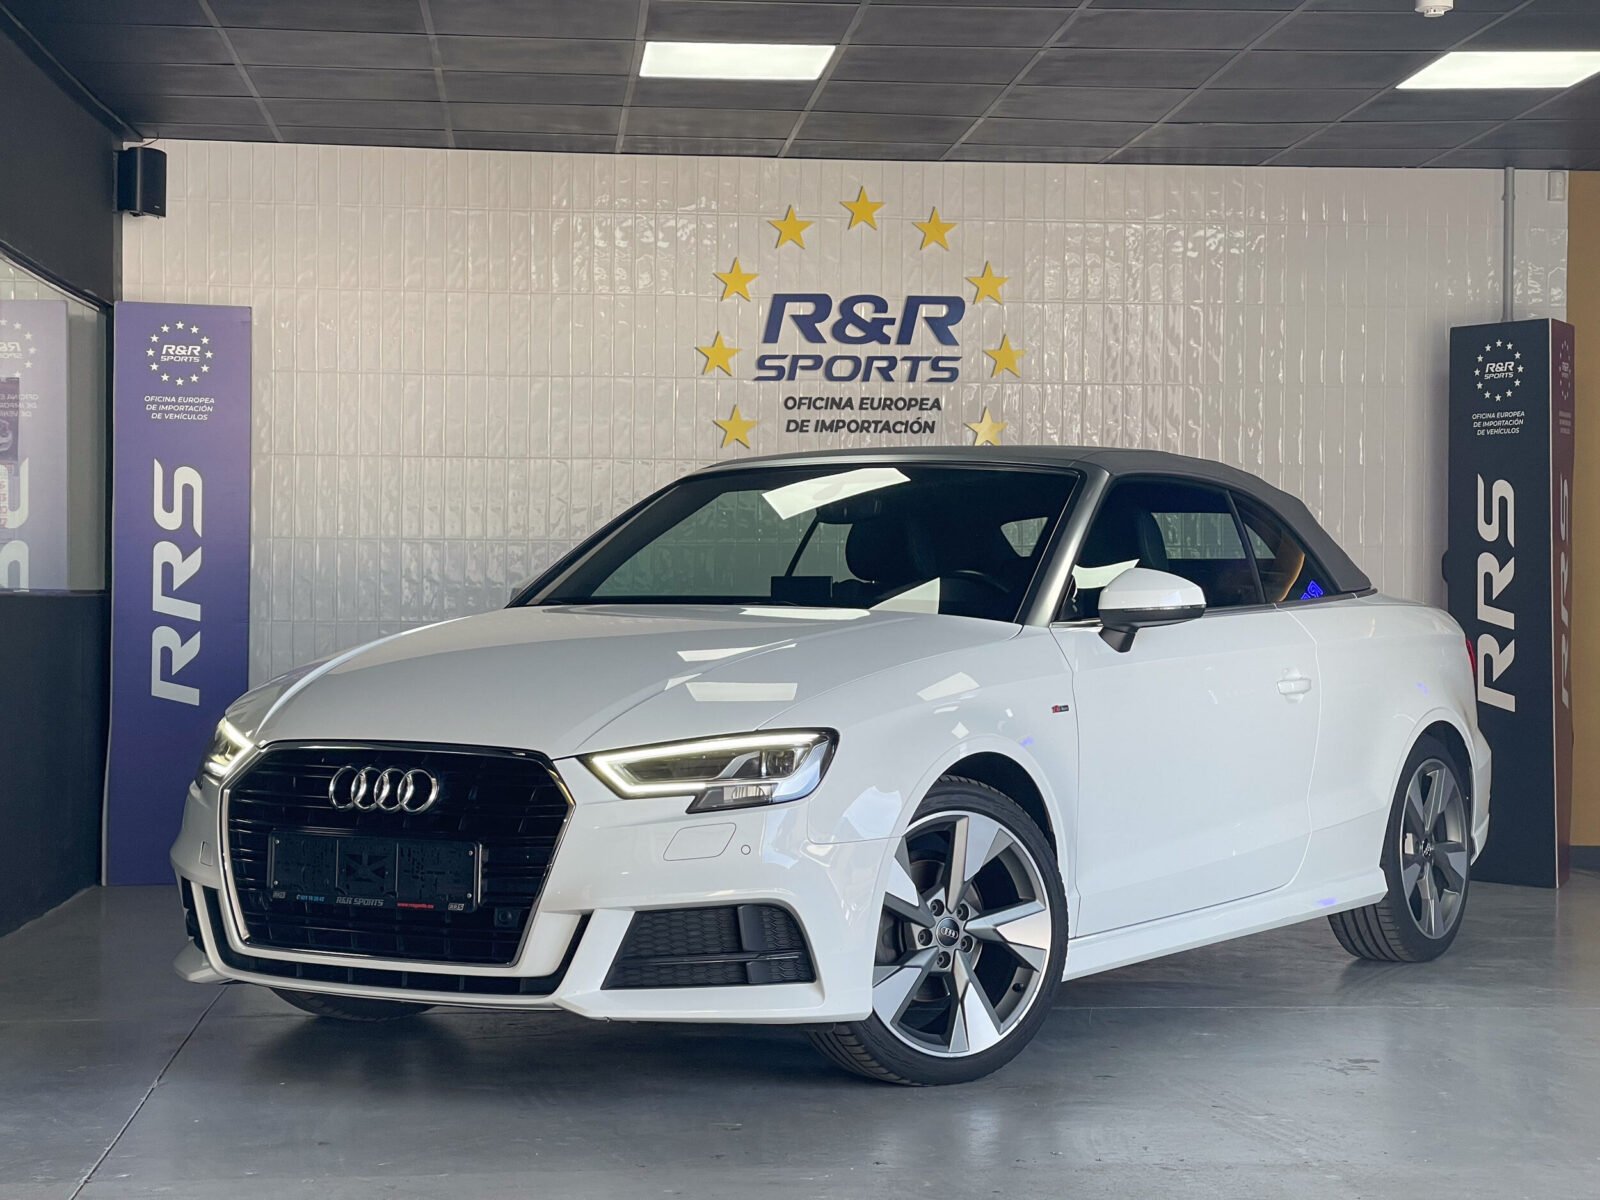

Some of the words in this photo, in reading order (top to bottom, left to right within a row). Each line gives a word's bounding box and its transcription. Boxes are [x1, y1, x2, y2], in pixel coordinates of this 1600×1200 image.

[762, 293, 966, 346] R&R
[162, 344, 200, 356] R&R
[160, 355, 200, 363] SPORTS
[753, 354, 962, 383] SPORTS
[1485, 361, 1514, 373] R&R
[1484, 371, 1514, 380] SPORTS
[144, 395, 176, 403] OFICINA
[177, 396, 215, 404] EUROPEA
[783, 396, 854, 411] OFICINA
[858, 397, 942, 412] EUROPEA
[158, 404, 213, 412] IMPORTACIÓN
[164, 412, 208, 421] VEHÍCULOS
[1472, 412, 1495, 420] OFICINA
[1496, 410, 1525, 418] EUROPEA
[785, 419, 811, 433] DE
[813, 416, 936, 434] IMPORTACIÓN
[1482, 418, 1524, 427] IMPORTACIÓN
[1486, 427, 1520, 435] VEHÍCULOS
[151, 458, 203, 706] RRS
[1476, 473, 1516, 713] RRS
[354, 897, 385, 907] SPORTS
